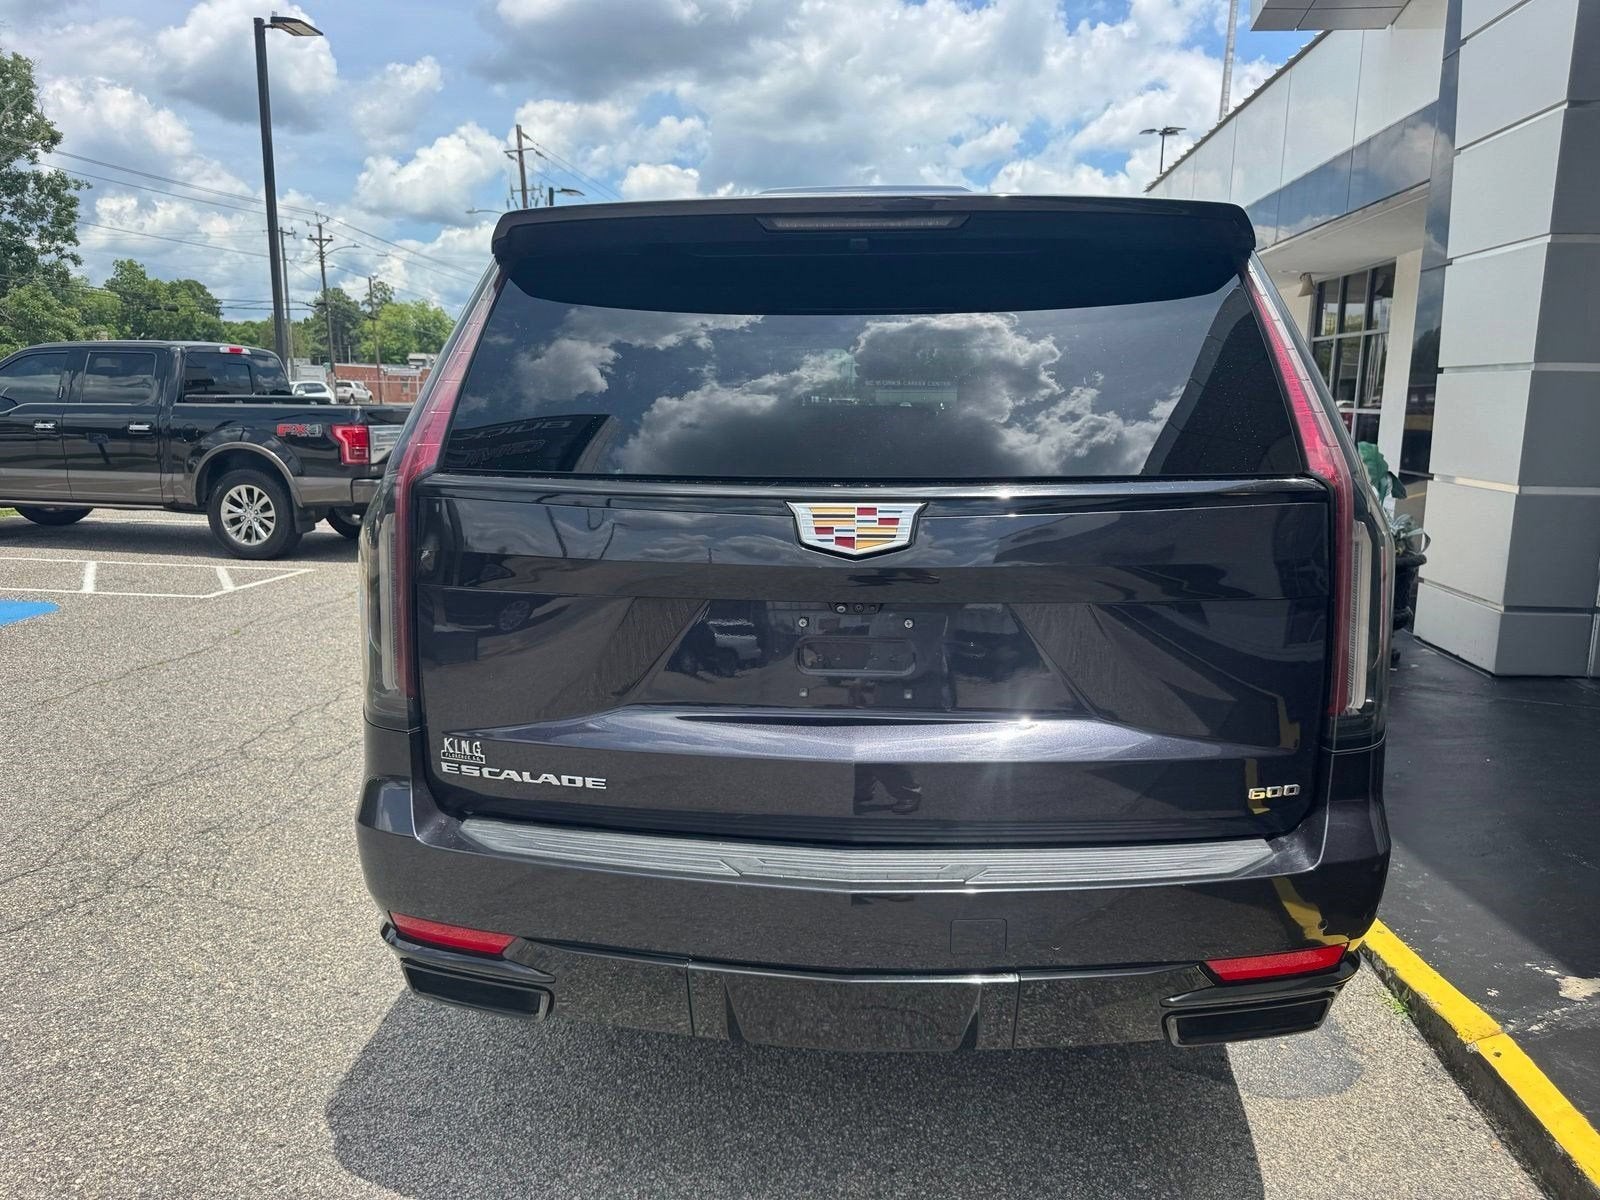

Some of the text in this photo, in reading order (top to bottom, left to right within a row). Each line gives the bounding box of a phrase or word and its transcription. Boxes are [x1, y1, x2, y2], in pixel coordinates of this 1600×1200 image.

[443, 737, 482, 756] KING
[440, 761, 607, 789] ESCALADE
[1248, 784, 1300, 799] 600
